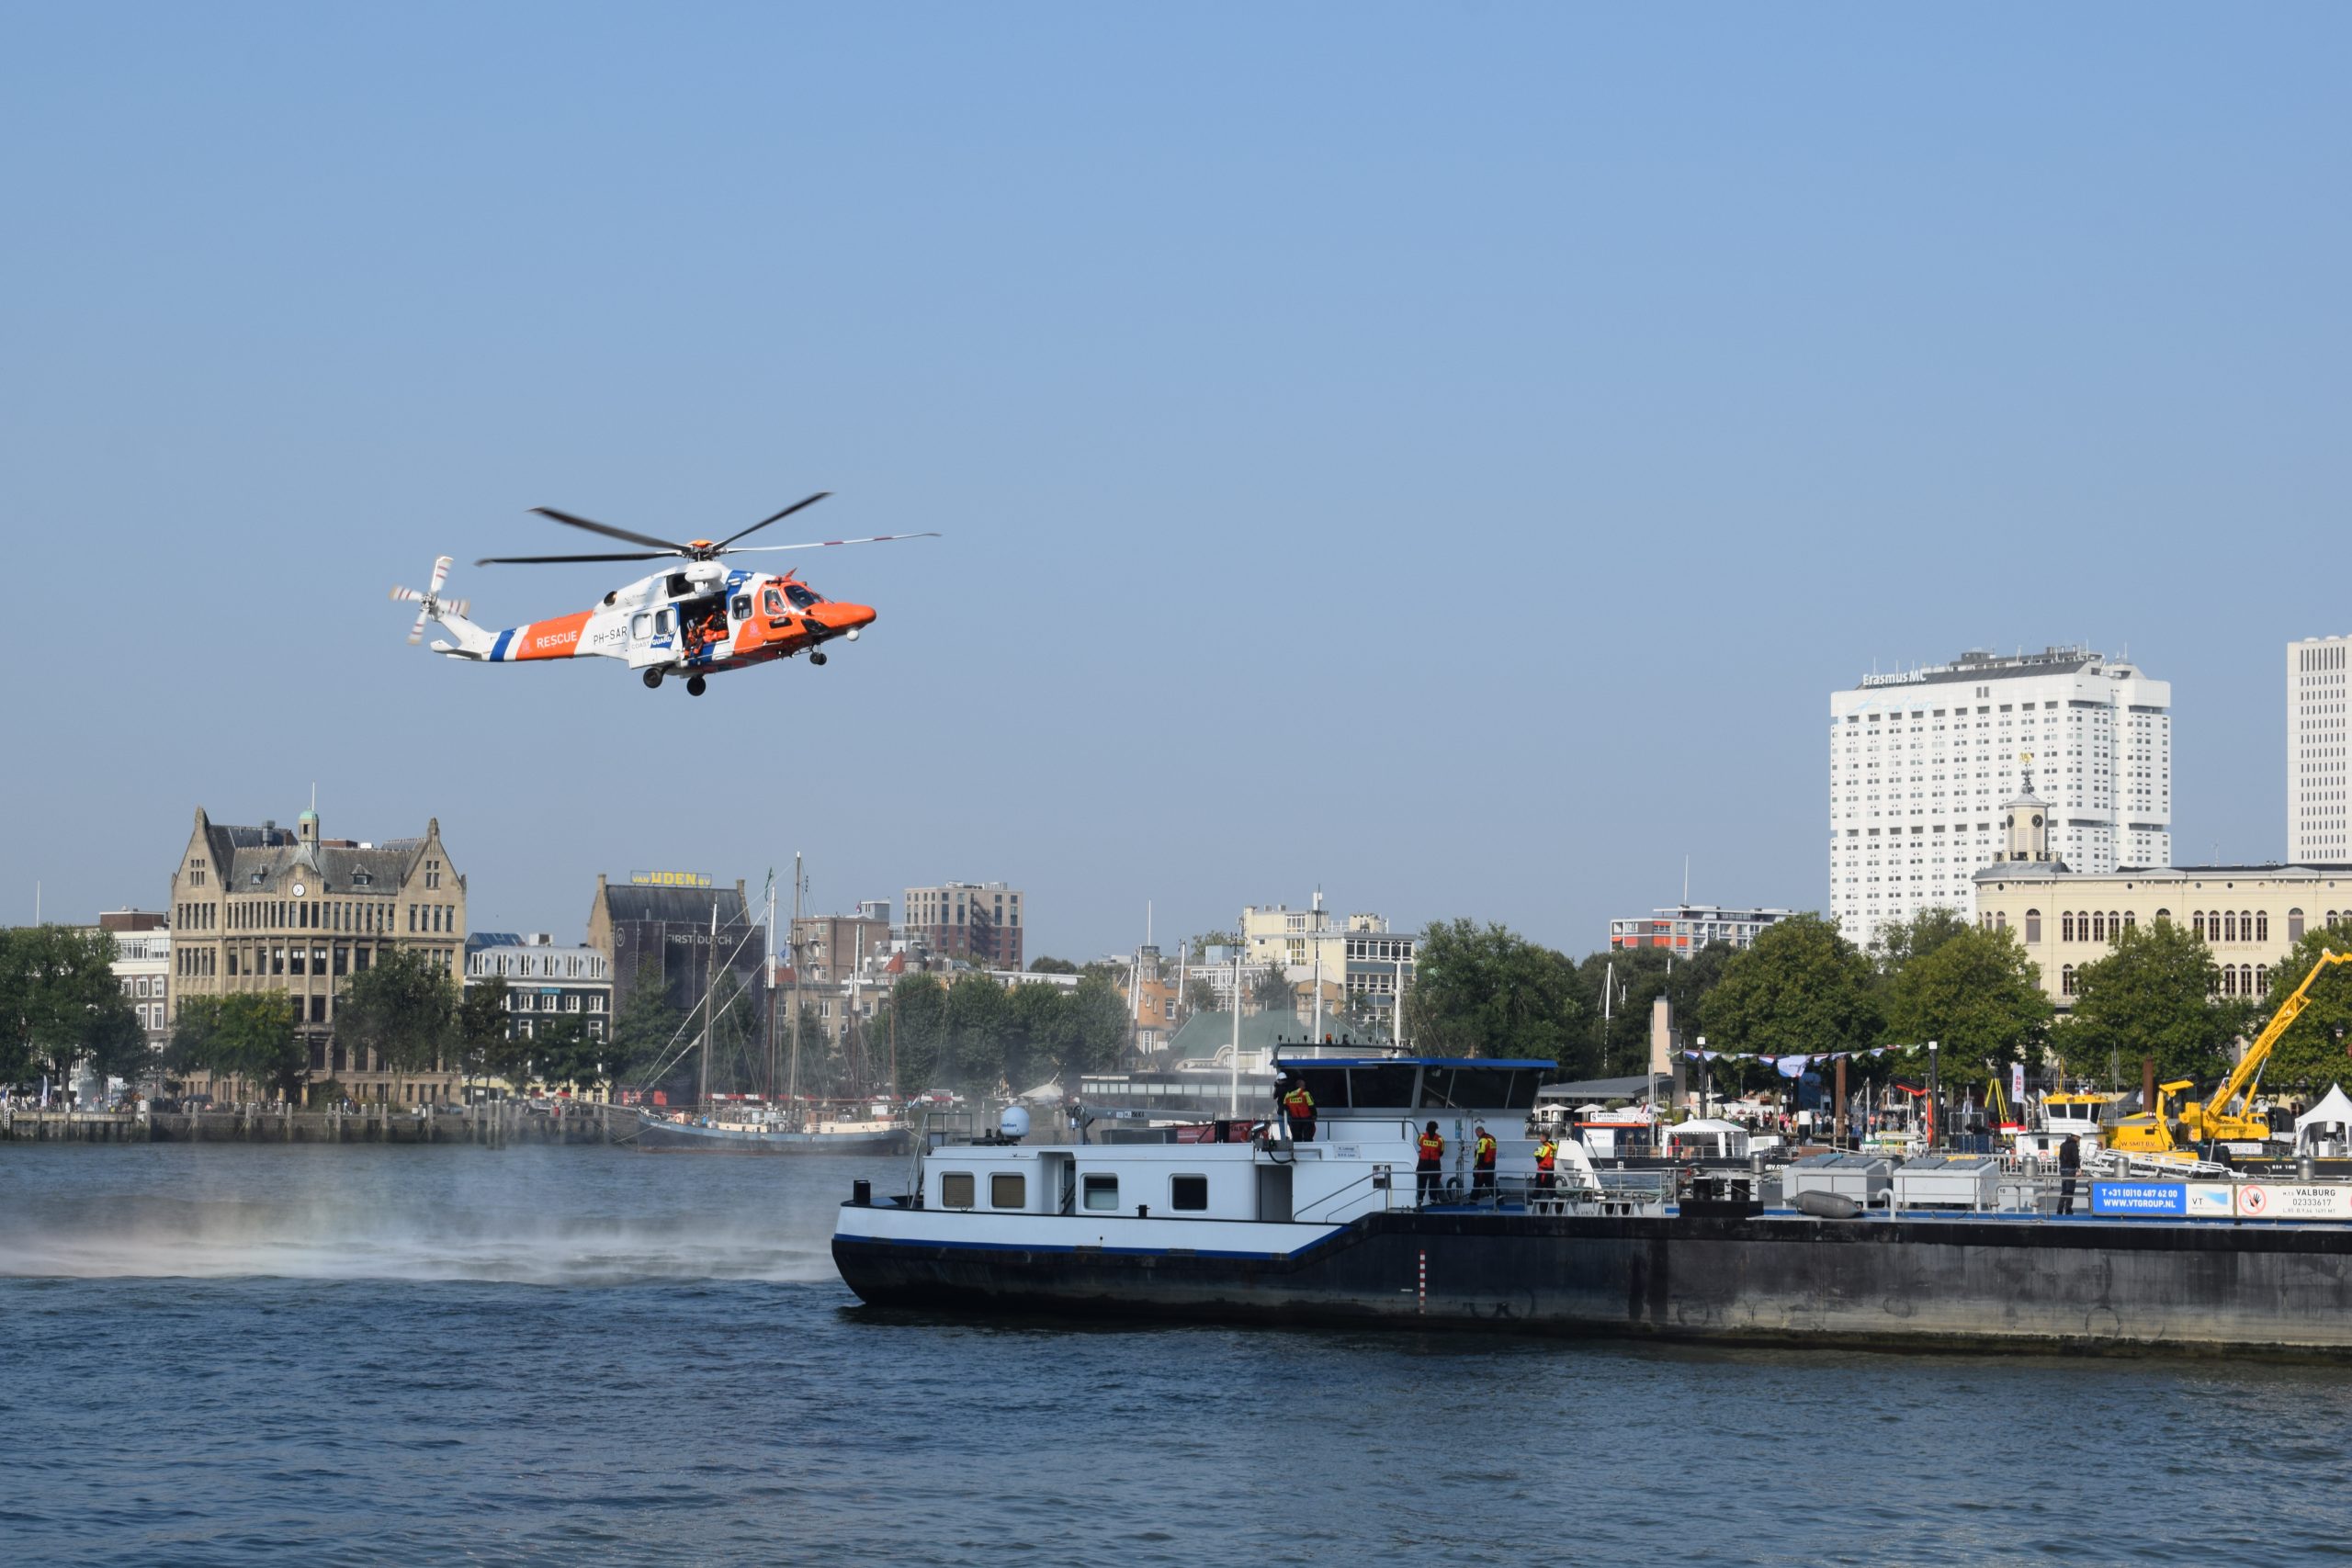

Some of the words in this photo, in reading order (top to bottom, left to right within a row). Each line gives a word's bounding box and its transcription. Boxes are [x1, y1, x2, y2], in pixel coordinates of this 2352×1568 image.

[537, 630, 577, 649] RESCUE
[594, 626, 628, 644] PH-SAR
[631, 640, 650, 650] COAST
[651, 636, 673, 646] GUARD
[631, 875, 650, 884] VAN
[650, 872, 697, 886] UDEN
[698, 878, 711, 886] BV
[666, 933, 694, 945] FIRST
[2101, 1188, 2108, 1198] T
[2108, 1189, 2121, 1198] +31
[2122, 1189, 2141, 1199] (0)10
[2143, 1189, 2156, 1198] 487
[2157, 1190, 2167, 1198] 62
[2168, 1190, 2177, 1199] 00
[2295, 1189, 2336, 1197] VALBURG
[2103, 1199, 2177, 1209] WWW.VTGROUP.NL
[2191, 1197, 2204, 1205] VT
[2292, 1198, 2332, 1206] 02333617
